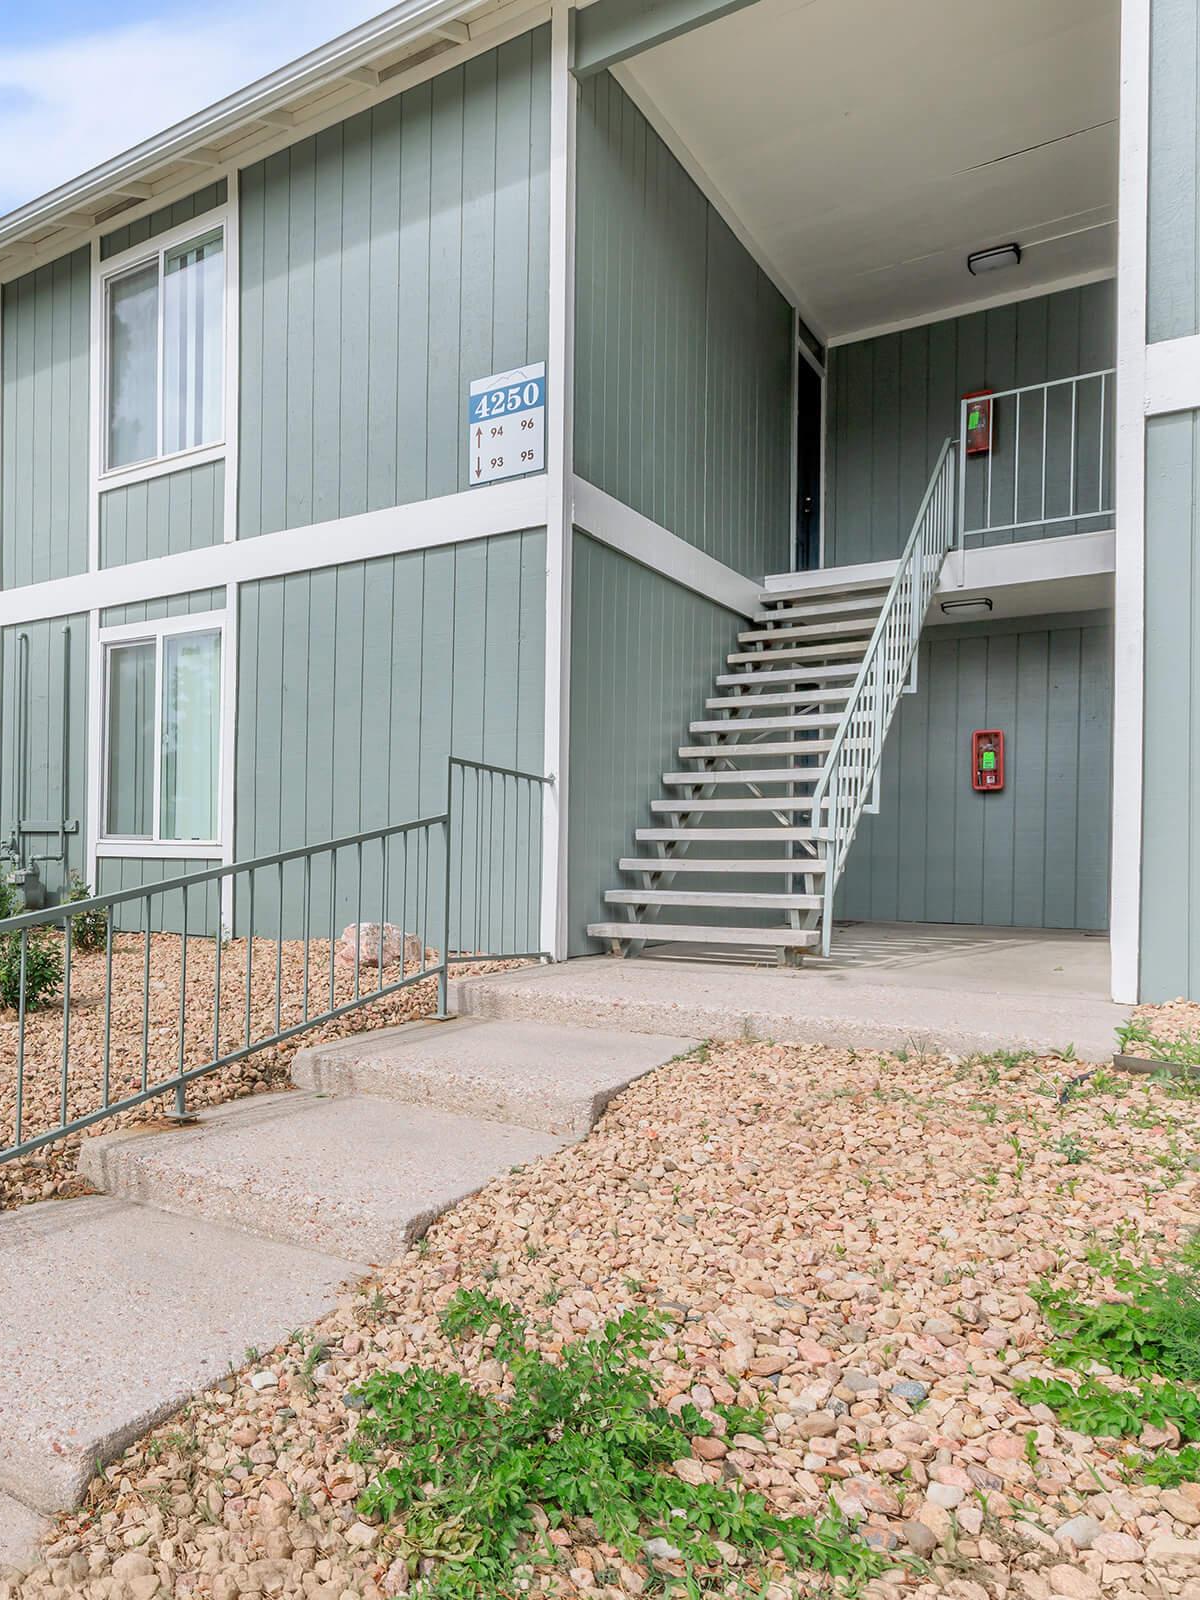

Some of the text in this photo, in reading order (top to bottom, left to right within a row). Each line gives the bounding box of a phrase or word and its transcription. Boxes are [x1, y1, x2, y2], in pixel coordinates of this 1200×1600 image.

[474, 382, 539, 418] 4250
[490, 418, 534, 438] 94 96
[490, 449, 534, 469] 93 95
